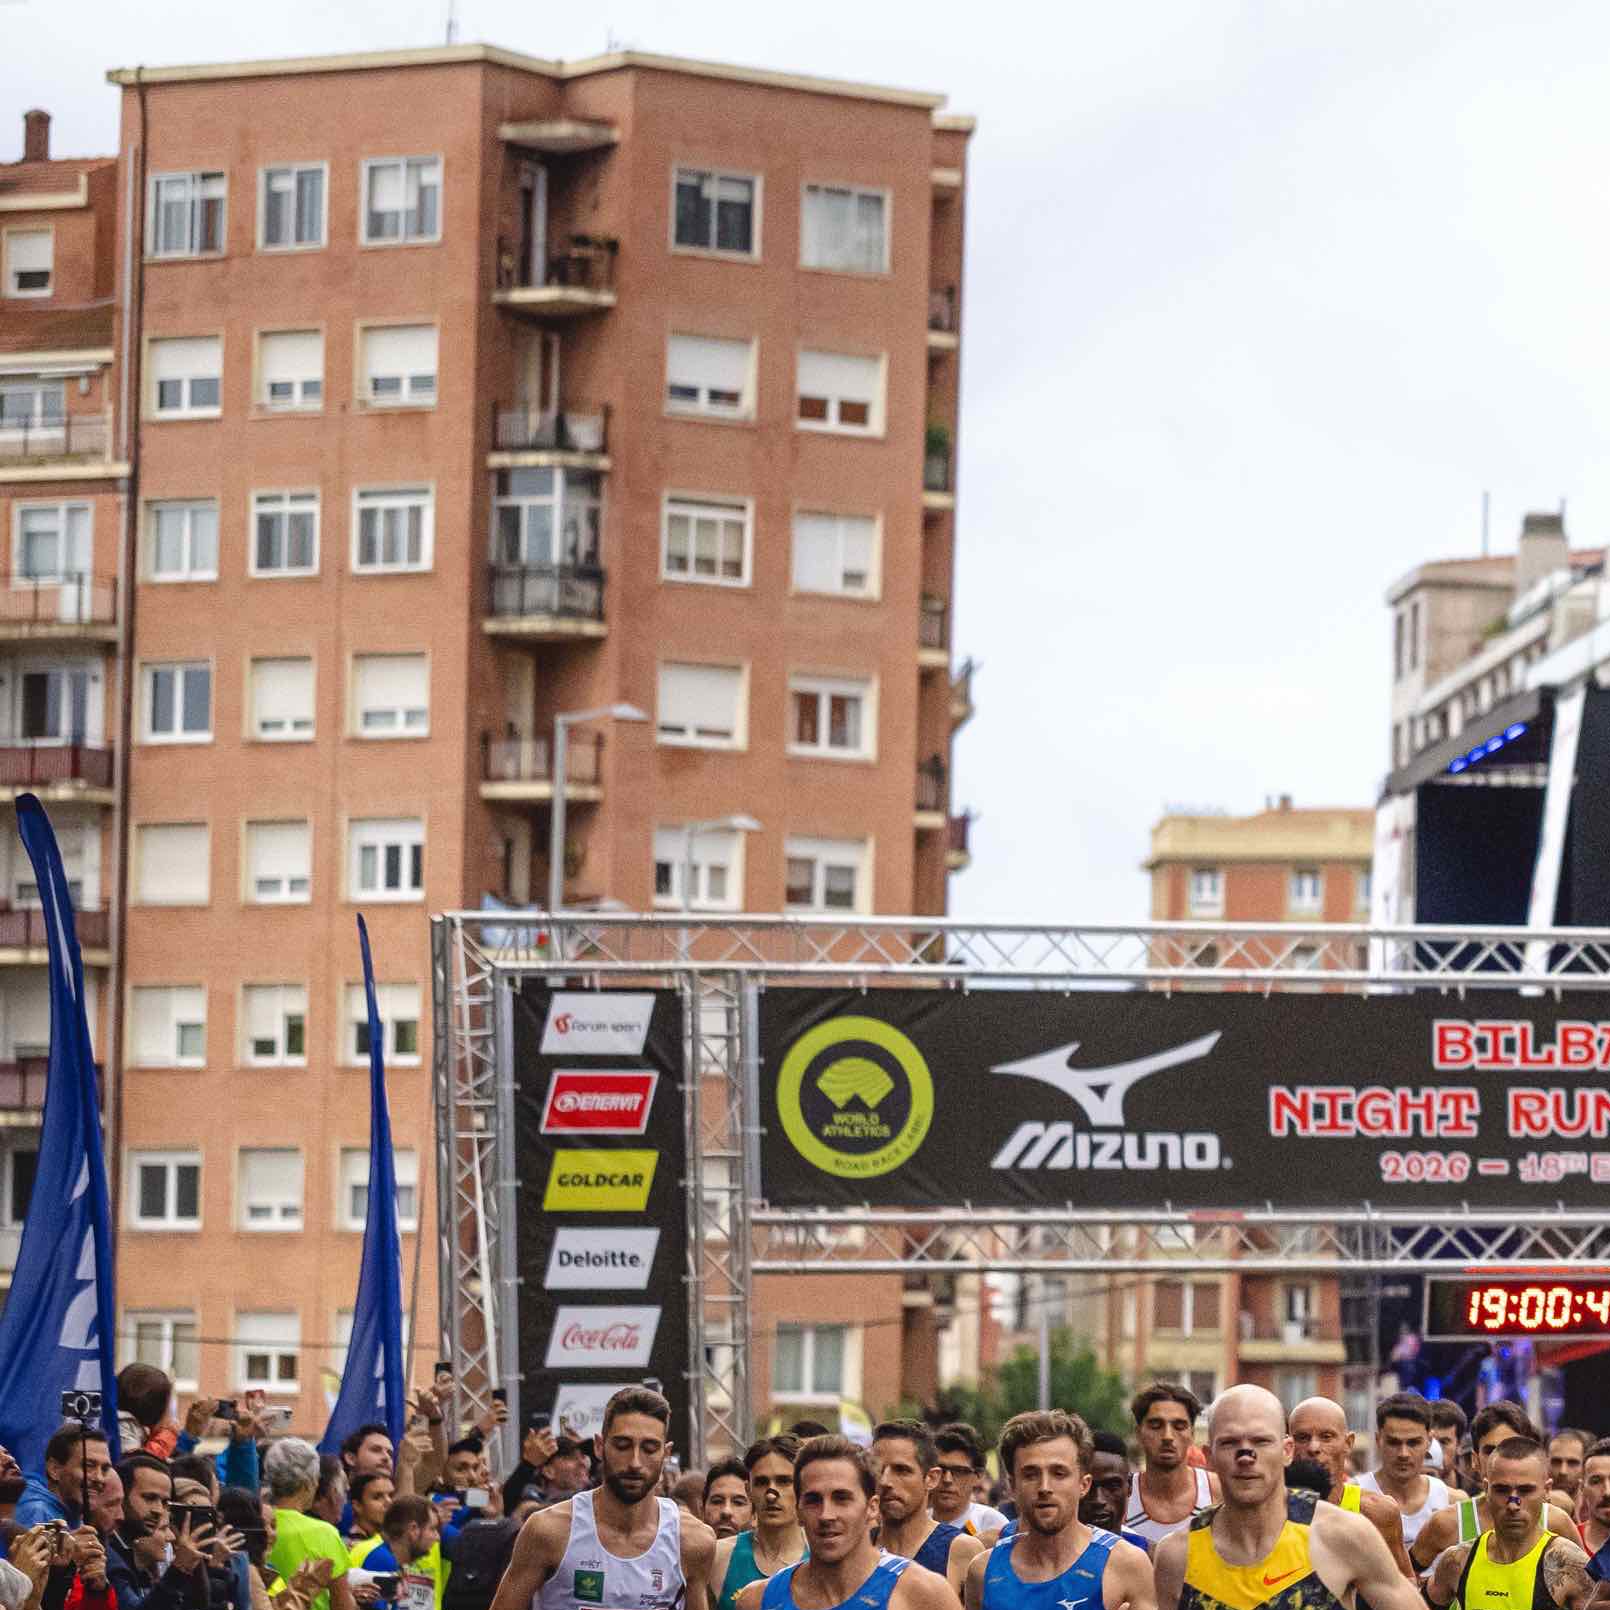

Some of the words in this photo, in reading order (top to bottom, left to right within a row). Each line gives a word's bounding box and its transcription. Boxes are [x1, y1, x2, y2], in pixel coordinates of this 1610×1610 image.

[1269, 1086, 1481, 1137] NIGHT
[558, 1173, 644, 1188] GOLDCAR
[1380, 1150, 1470, 1183] 2026
